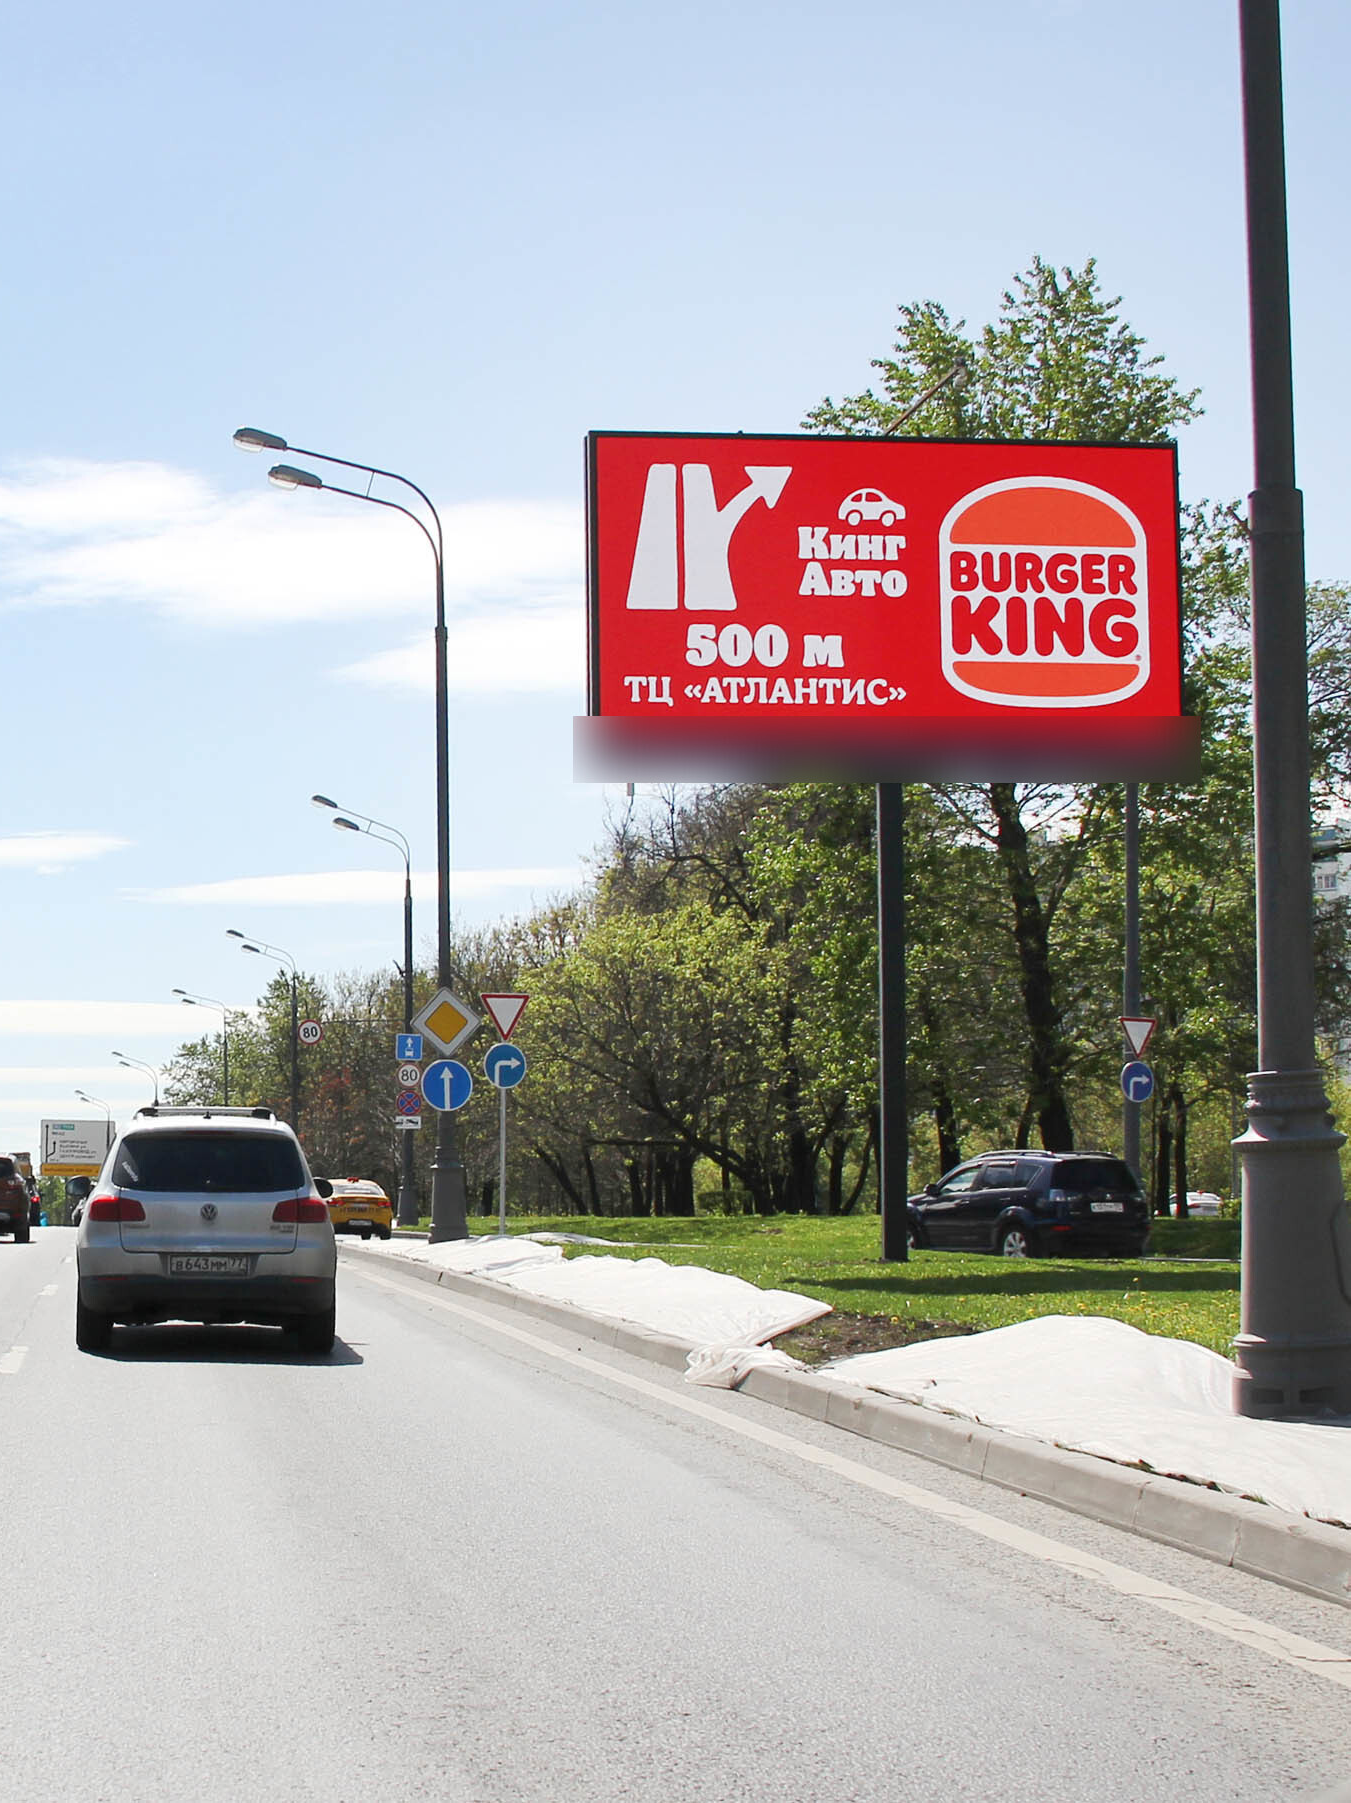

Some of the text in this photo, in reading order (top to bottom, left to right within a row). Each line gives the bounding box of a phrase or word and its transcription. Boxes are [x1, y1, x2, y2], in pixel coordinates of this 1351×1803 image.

[798, 526, 906, 560] Кинг
[798, 561, 908, 598] Авто
[950, 551, 1138, 595] BURGER
[951, 595, 1139, 658] KING
[685, 624, 845, 668] 500 м
[624, 676, 907, 707] ТЦ «АТЛАНТИС»
[302, 1026, 318, 1039] 80
[401, 1069, 418, 1082] 80
